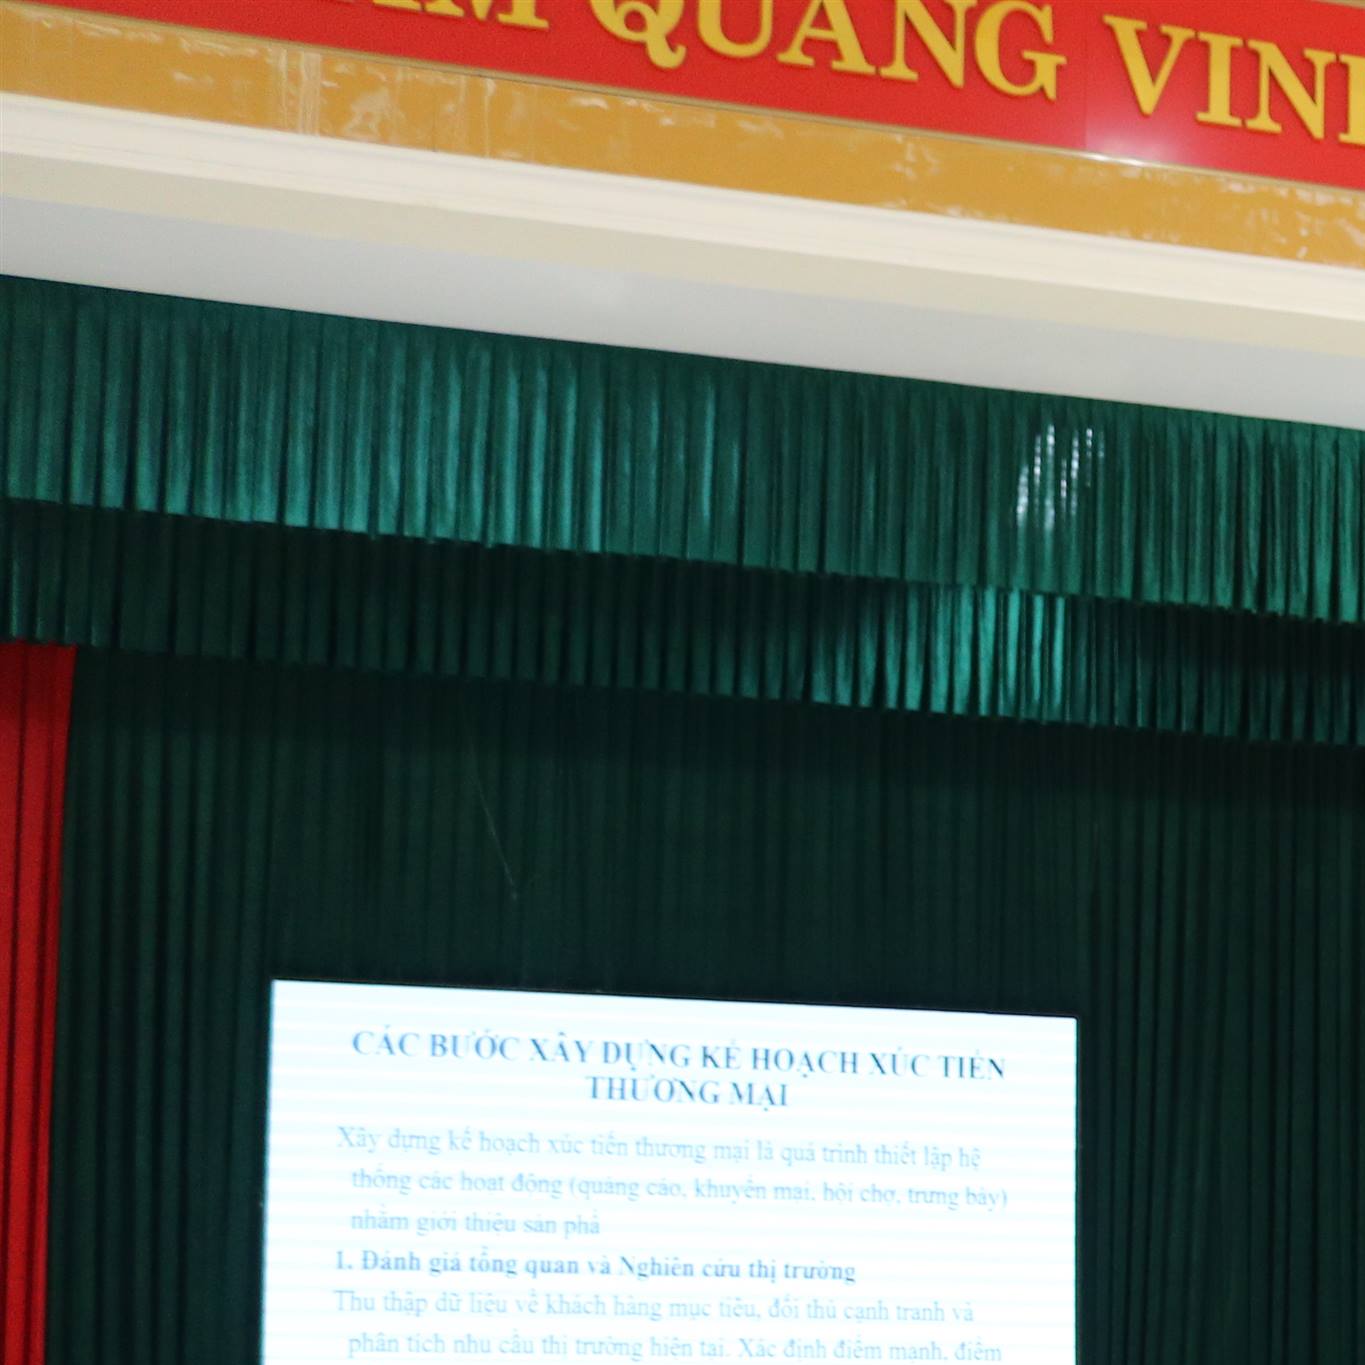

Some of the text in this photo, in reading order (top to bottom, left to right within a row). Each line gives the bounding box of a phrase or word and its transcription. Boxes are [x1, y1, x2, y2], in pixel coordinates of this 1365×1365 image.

[588, 0, 1068, 101] QUANG
[352, 1024, 1006, 1080] CÁC BƯỚC XÂY DỰNG KẾ HOẠCH XÚC TIẾN
[585, 1073, 789, 1112] THƯƠNG MẠI
[336, 1125, 386, 1153] Xây
[388, 1128, 440, 1155] dựng
[448, 1125, 473, 1151] kế
[479, 1130, 540, 1156] hoạch
[548, 1134, 584, 1155] xúc
[636, 1136, 705, 1164] thương
[757, 1139, 773, 1161] là
[780, 1142, 815, 1167] quá
[822, 1143, 867, 1164] trình
[924, 1145, 952, 1172] lập
[959, 1146, 982, 1169] hệ
[418, 1170, 452, 1191] các
[335, 1250, 352, 1271] 1.
[362, 1249, 420, 1271] Đánh
[429, 1253, 461, 1277] giá
[470, 1245, 517, 1276] tổng
[524, 1257, 579, 1278] quan
[587, 1255, 610, 1276] và
[618, 1255, 693, 1281] Nghiên
[748, 1258, 776, 1284] thị
[784, 1257, 856, 1285] trường
[333, 1289, 375, 1313] Thu
[546, 1293, 606, 1316] khách
[896, 1300, 944, 1322] tranh
[454, 1334, 491, 1354] nhu
